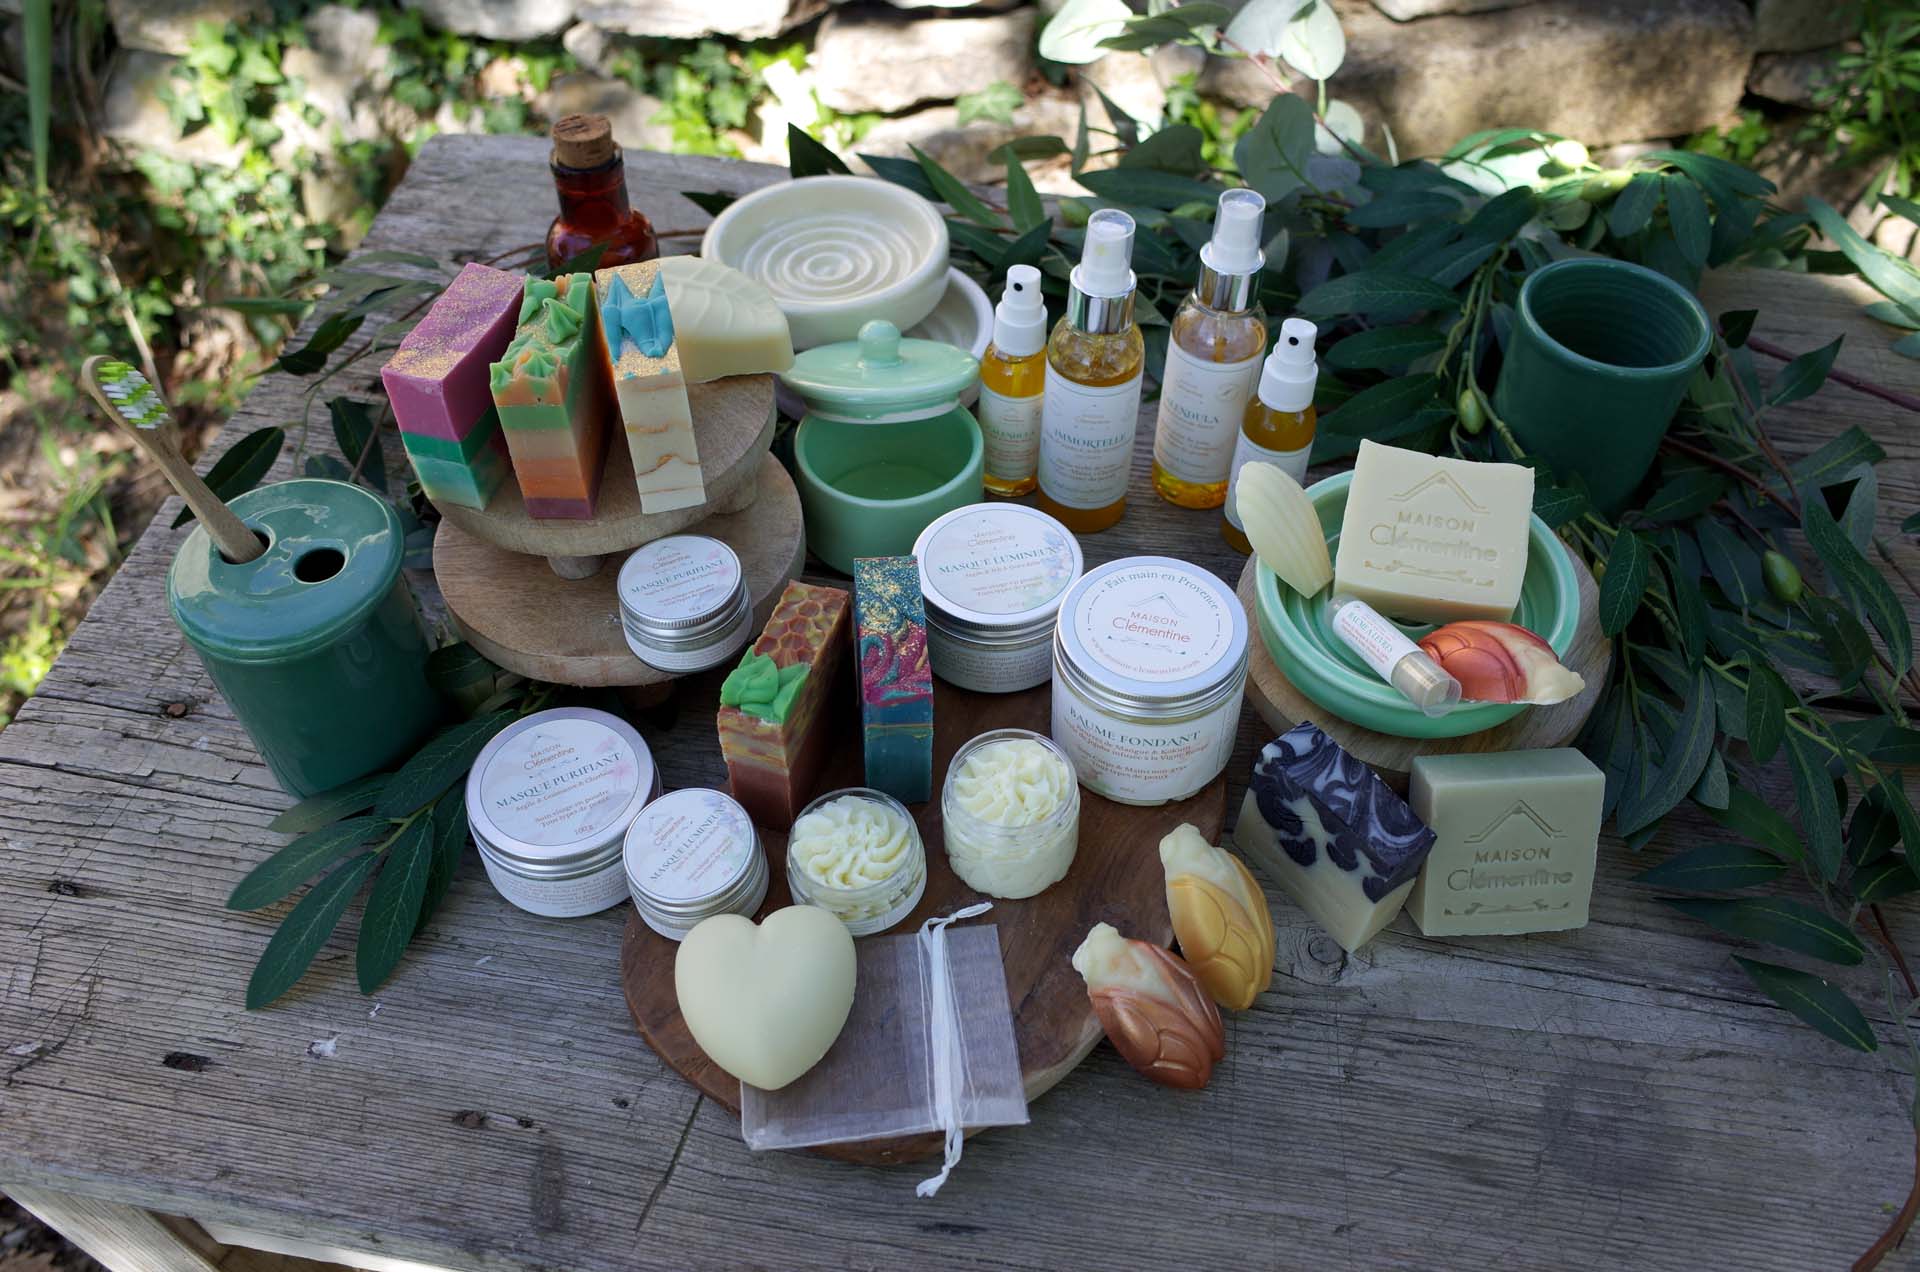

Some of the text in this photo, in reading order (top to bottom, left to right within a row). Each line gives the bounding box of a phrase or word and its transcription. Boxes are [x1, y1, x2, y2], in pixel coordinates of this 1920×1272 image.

[1054, 429, 1127, 449] IMMORTELLE
[1397, 511, 1476, 533] MAISON
[1369, 524, 1499, 562] Clémentine
[938, 558, 992, 575] MASQUE
[993, 546, 1058, 566] LUMINEUX
[631, 575, 672, 593] MASQUE
[673, 559, 724, 580] PURIFIANT
[1104, 571, 1219, 610] Fait main en Provence
[1112, 616, 1192, 643] Clémentine
[1130, 611, 1178, 627] MAISON
[1070, 706, 1202, 747] BAUME FONDANT
[523, 747, 575, 770] Clémentine
[530, 743, 561, 758] MAISON
[496, 752, 622, 809] MASQUE PURIFIANT
[649, 847, 684, 881] MASQUE
[683, 808, 725, 850] LUMINEUX
[1474, 847, 1551, 864] MAISON
[1448, 868, 1573, 891] Clémentine
